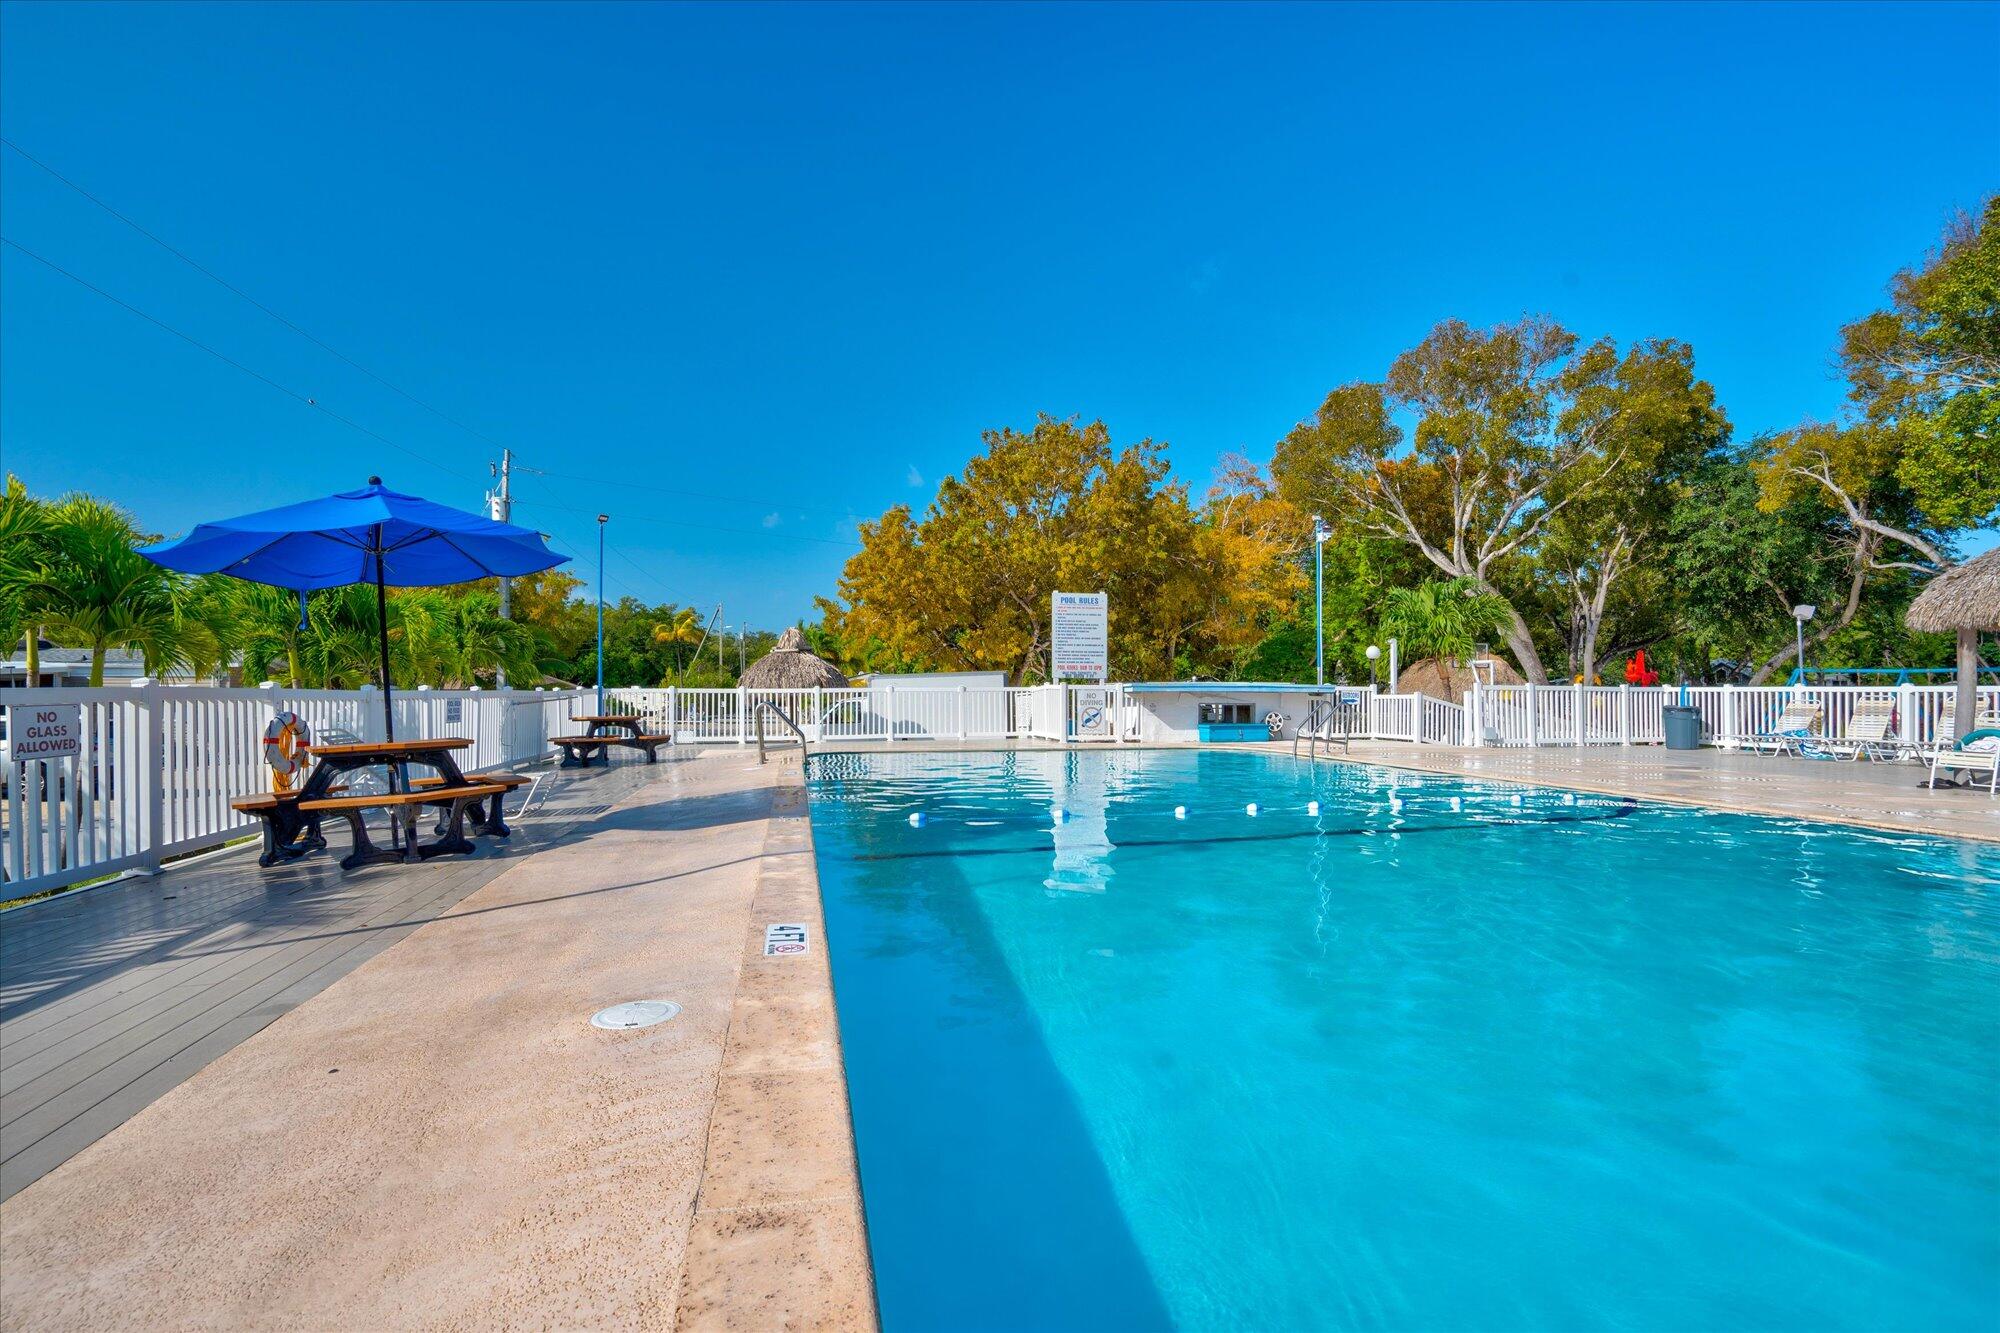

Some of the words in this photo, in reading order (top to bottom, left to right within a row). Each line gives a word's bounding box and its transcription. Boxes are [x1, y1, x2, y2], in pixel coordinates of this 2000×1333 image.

[1060, 596, 1076, 604] POOL
[1079, 597, 1099, 605] RULES
[36, 711, 58, 723] NO
[26, 725, 67, 739] GLASS
[16, 739, 76, 754] ALLOWED
